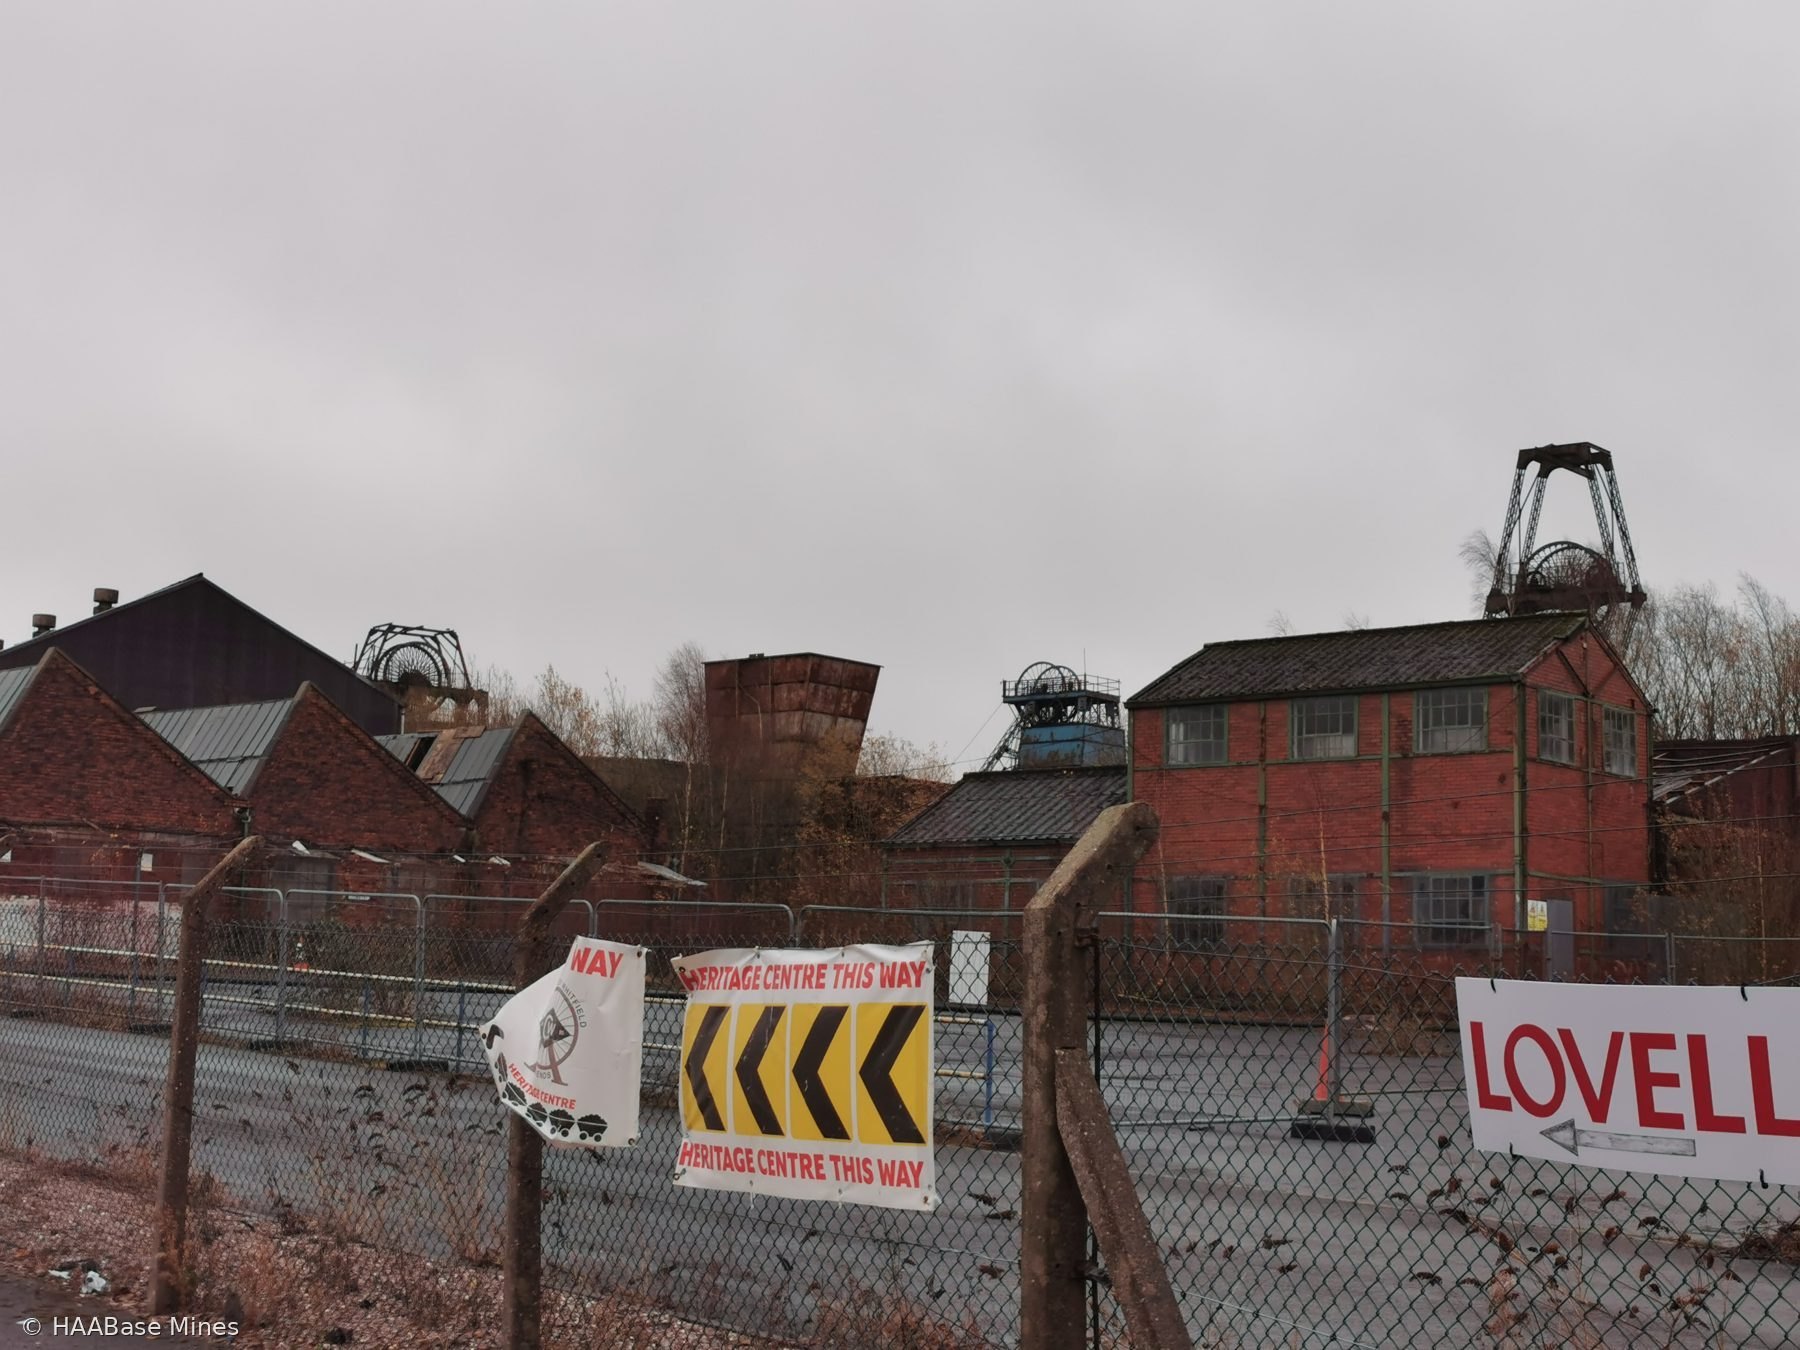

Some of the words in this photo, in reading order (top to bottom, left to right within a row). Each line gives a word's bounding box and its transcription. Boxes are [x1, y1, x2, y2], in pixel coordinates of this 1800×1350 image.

[571, 947, 624, 979] WAY
[680, 965, 762, 991] HERITAGE
[763, 963, 828, 990] CENTRE
[833, 962, 875, 989] THIS
[880, 961, 926, 989] WAY
[1470, 1021, 1800, 1137] LOVELL
[679, 1142, 755, 1173] HERITAGE
[757, 1149, 826, 1180] CENTRE
[829, 1154, 874, 1184] THIS
[877, 1158, 924, 1188] WAY
